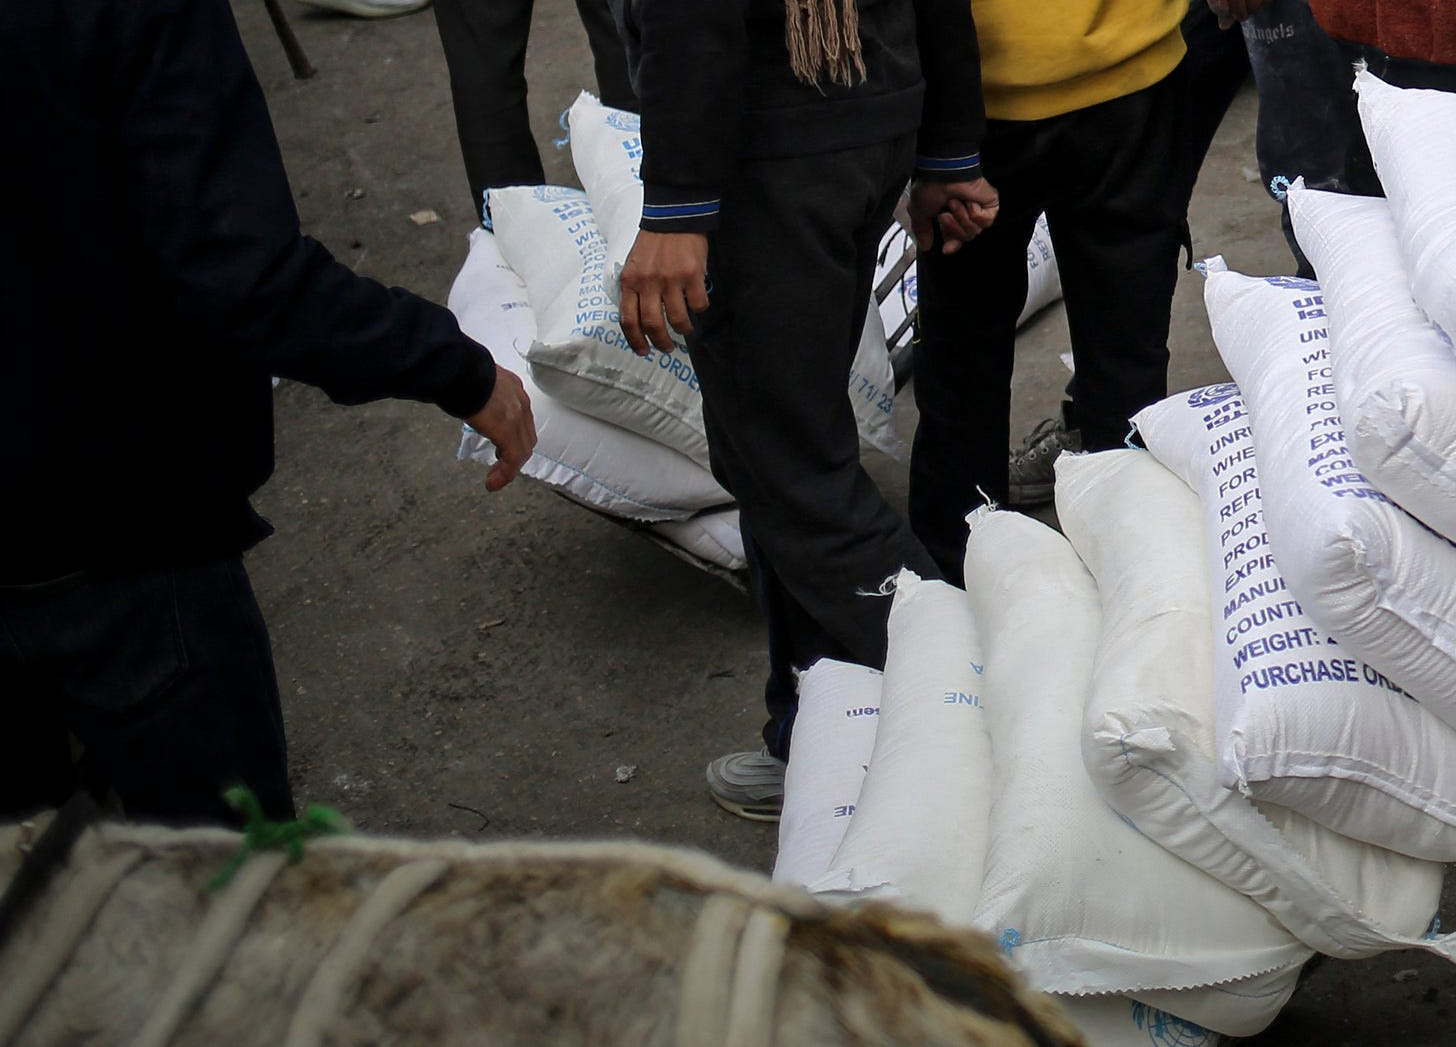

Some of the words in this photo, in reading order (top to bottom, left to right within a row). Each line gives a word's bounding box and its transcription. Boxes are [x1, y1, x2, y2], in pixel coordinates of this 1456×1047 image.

[1212, 446, 1255, 477] WHE
[1223, 577, 1287, 620] MANU
[1233, 628, 1320, 680] WEIGHT:
[1240, 658, 1360, 695] PURCHASE
